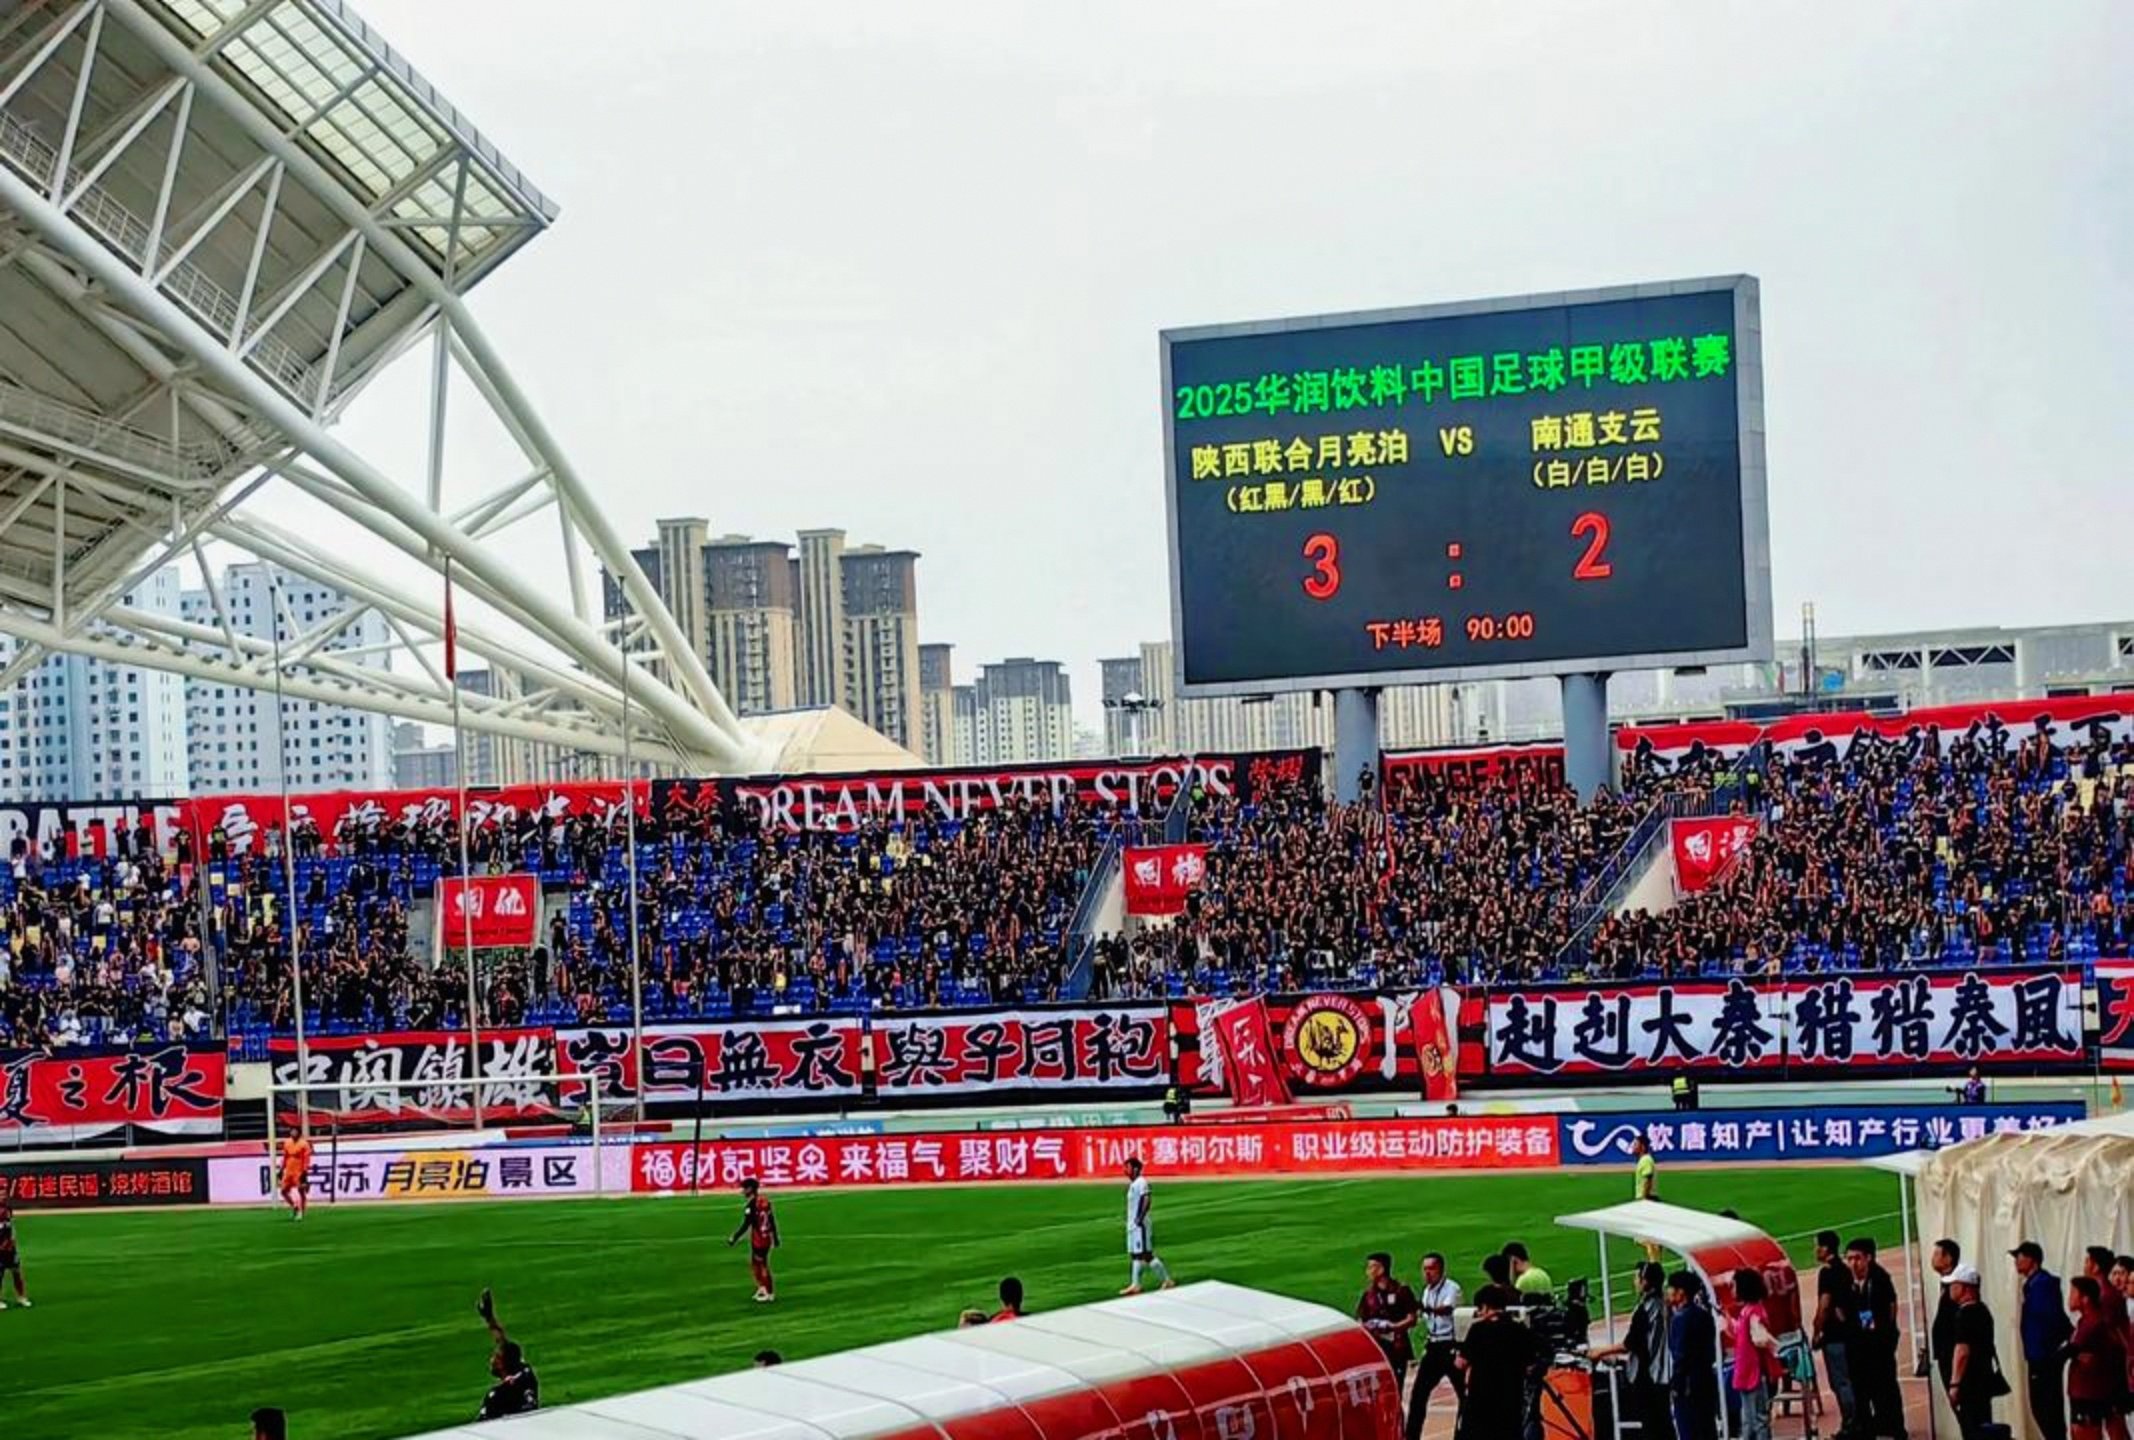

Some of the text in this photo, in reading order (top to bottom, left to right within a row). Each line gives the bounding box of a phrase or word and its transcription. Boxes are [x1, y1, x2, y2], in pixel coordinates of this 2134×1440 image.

[1176, 333, 1730, 419] 2025华润饮料中国足球甲级联赛
[1191, 408, 1662, 480] 陕西联合月亮泊 VS 南通支云
[1303, 533, 1340, 599] 3
[1570, 511, 1612, 579] 2
[1366, 614, 1534, 650] 下半场 90:00
[0, 805, 181, 860] BATTLE
[735, 781, 906, 834] DREAM
[1495, 978, 1776, 1074] 赳赳大秦
[379, 1159, 491, 1193] 月亮泊
[499, 1155, 578, 1189] 景区
[840, 1140, 945, 1181] 来福气
[959, 1136, 1067, 1177] 聚财气
